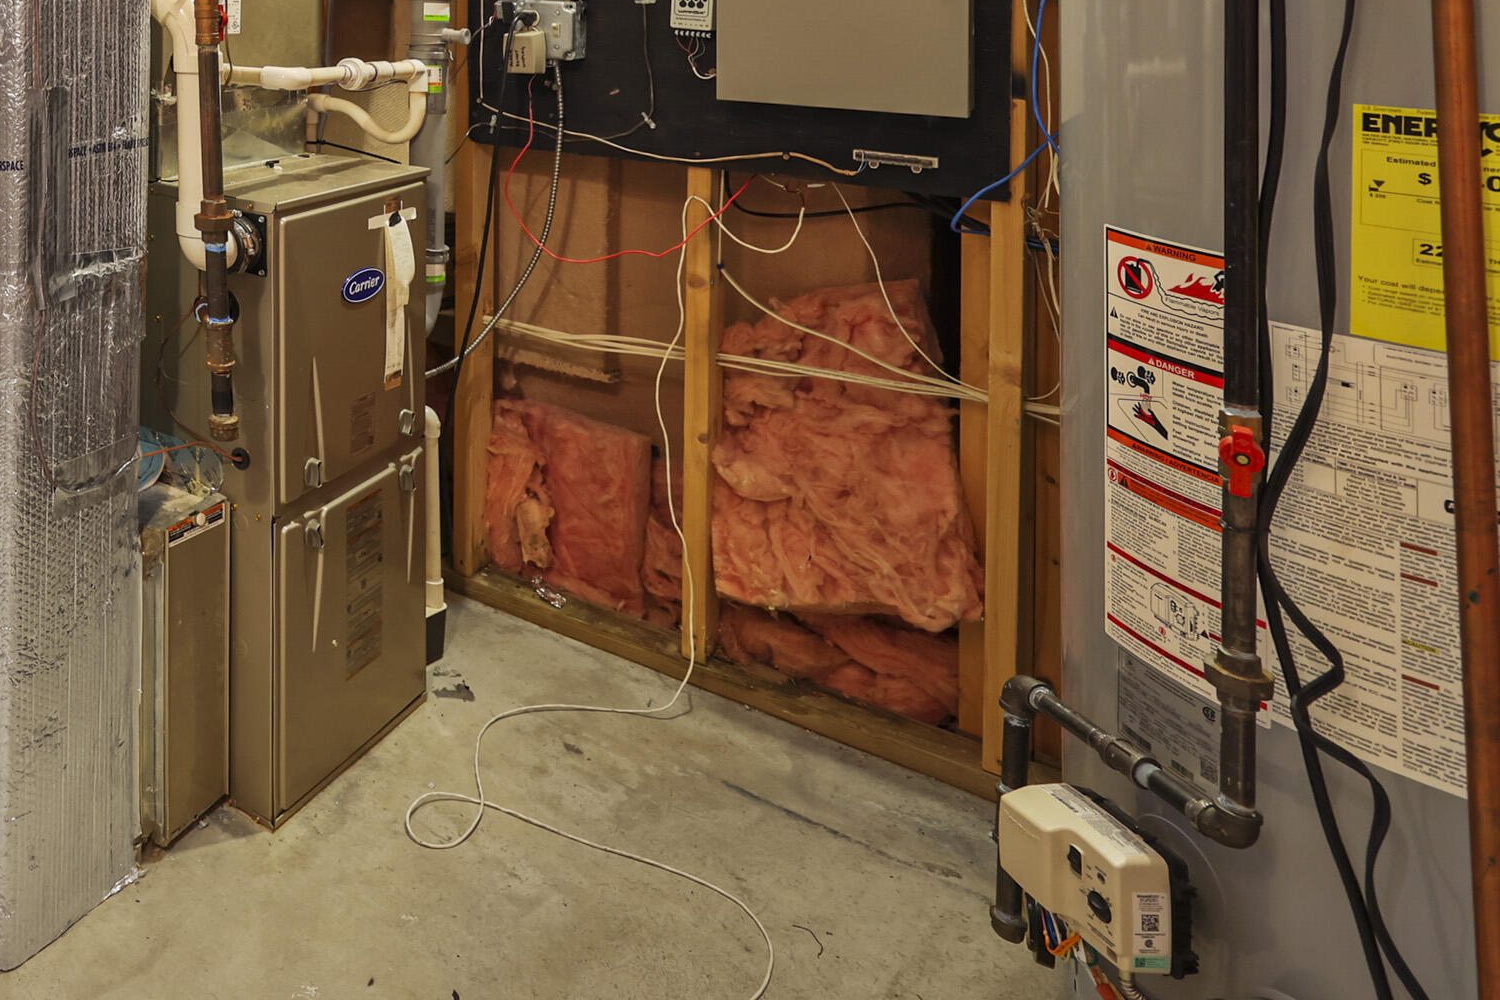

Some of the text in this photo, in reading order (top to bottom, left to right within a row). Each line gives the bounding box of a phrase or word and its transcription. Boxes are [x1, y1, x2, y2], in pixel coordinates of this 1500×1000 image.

[1362, 112, 1438, 138] ENER
[1386, 156, 1436, 168] Estimated
[1418, 172, 1432, 186] $
[1153, 244, 1197, 262] WARNING
[348, 276, 380, 295] Carrier
[1357, 274, 1378, 284] Your
[1418, 285, 1444, 295] depe
[1155, 359, 1195, 379] DANGER
